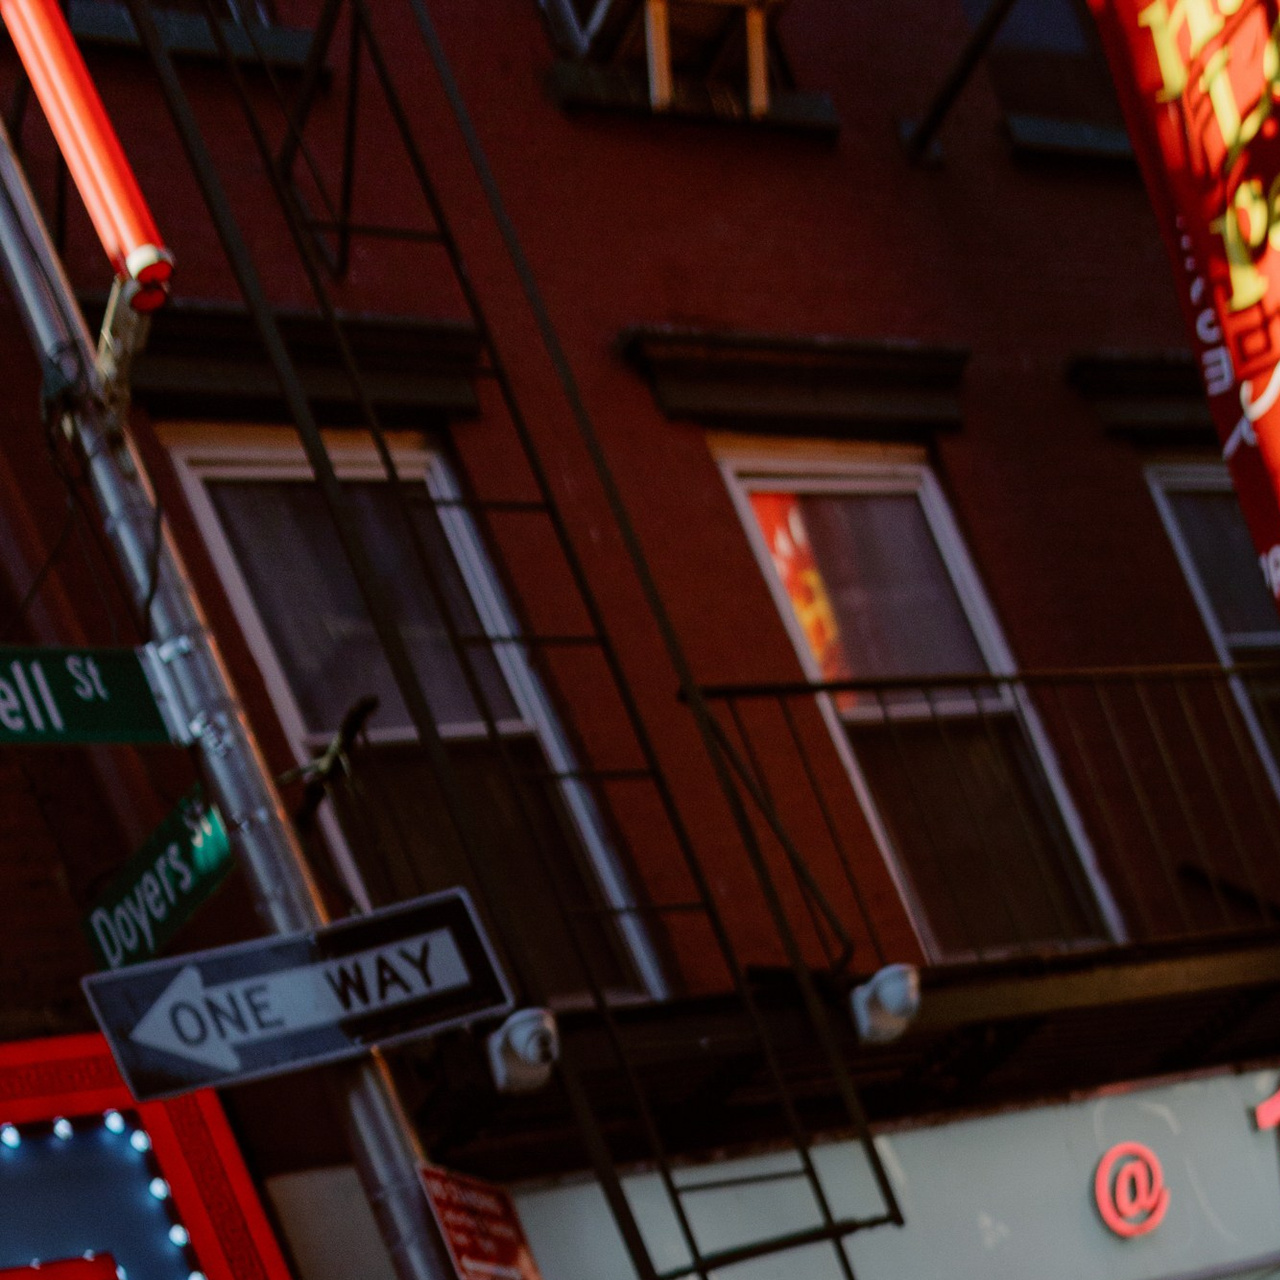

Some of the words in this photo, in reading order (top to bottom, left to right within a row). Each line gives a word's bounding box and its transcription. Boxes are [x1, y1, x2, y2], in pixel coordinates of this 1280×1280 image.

[0, 659, 64, 731] ell
[65, 653, 110, 701] St
[90, 841, 194, 970] Doyers
[168, 983, 285, 1047] ONE
[323, 940, 434, 1012] WAY
[1095, 1140, 1169, 1239] @
